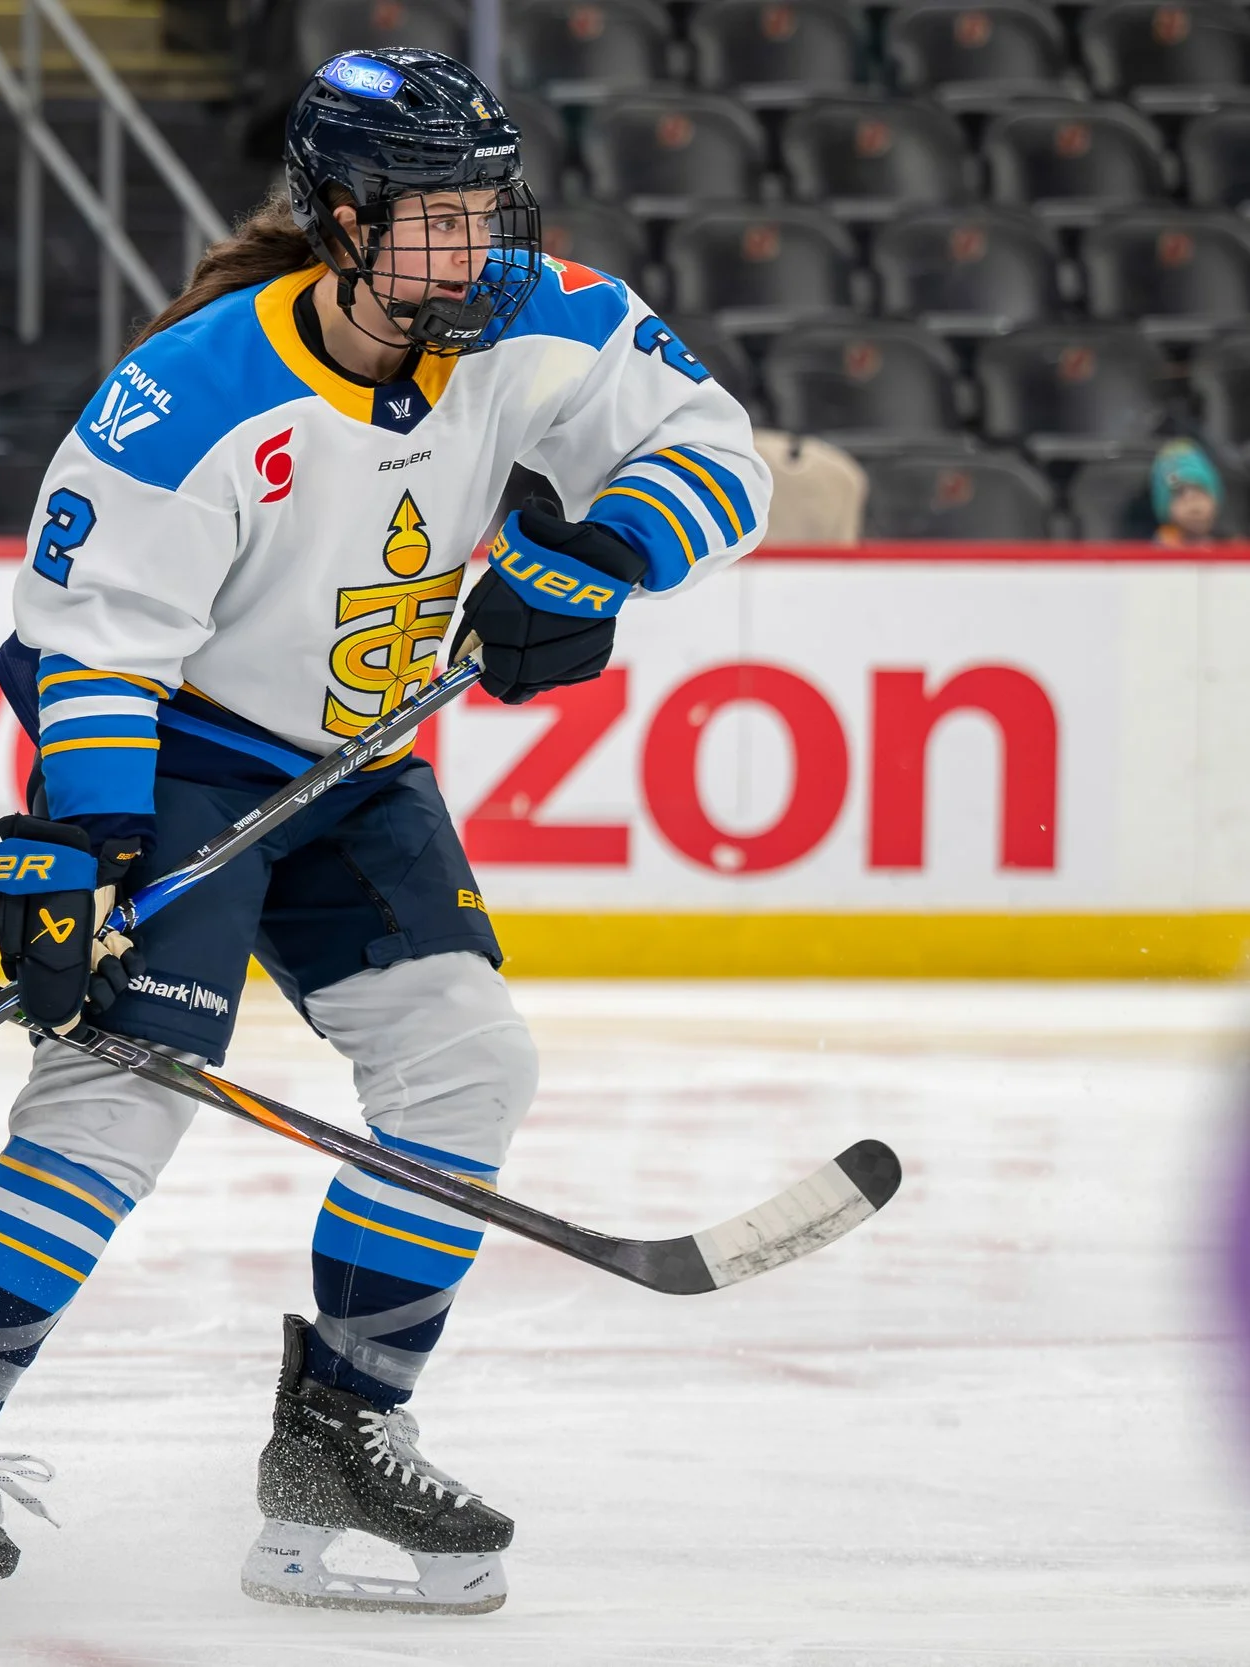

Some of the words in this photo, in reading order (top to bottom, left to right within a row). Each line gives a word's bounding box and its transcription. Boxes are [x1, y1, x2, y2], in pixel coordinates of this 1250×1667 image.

[330, 59, 394, 93] Royale
[474, 144, 516, 158] BAUER
[633, 314, 713, 385] 2
[120, 361, 173, 415] PWHL
[32, 487, 98, 589] 2
[485, 529, 615, 612] AUER
[311, 738, 384, 798] BAUER
[303, 1405, 344, 1429] TRUE
